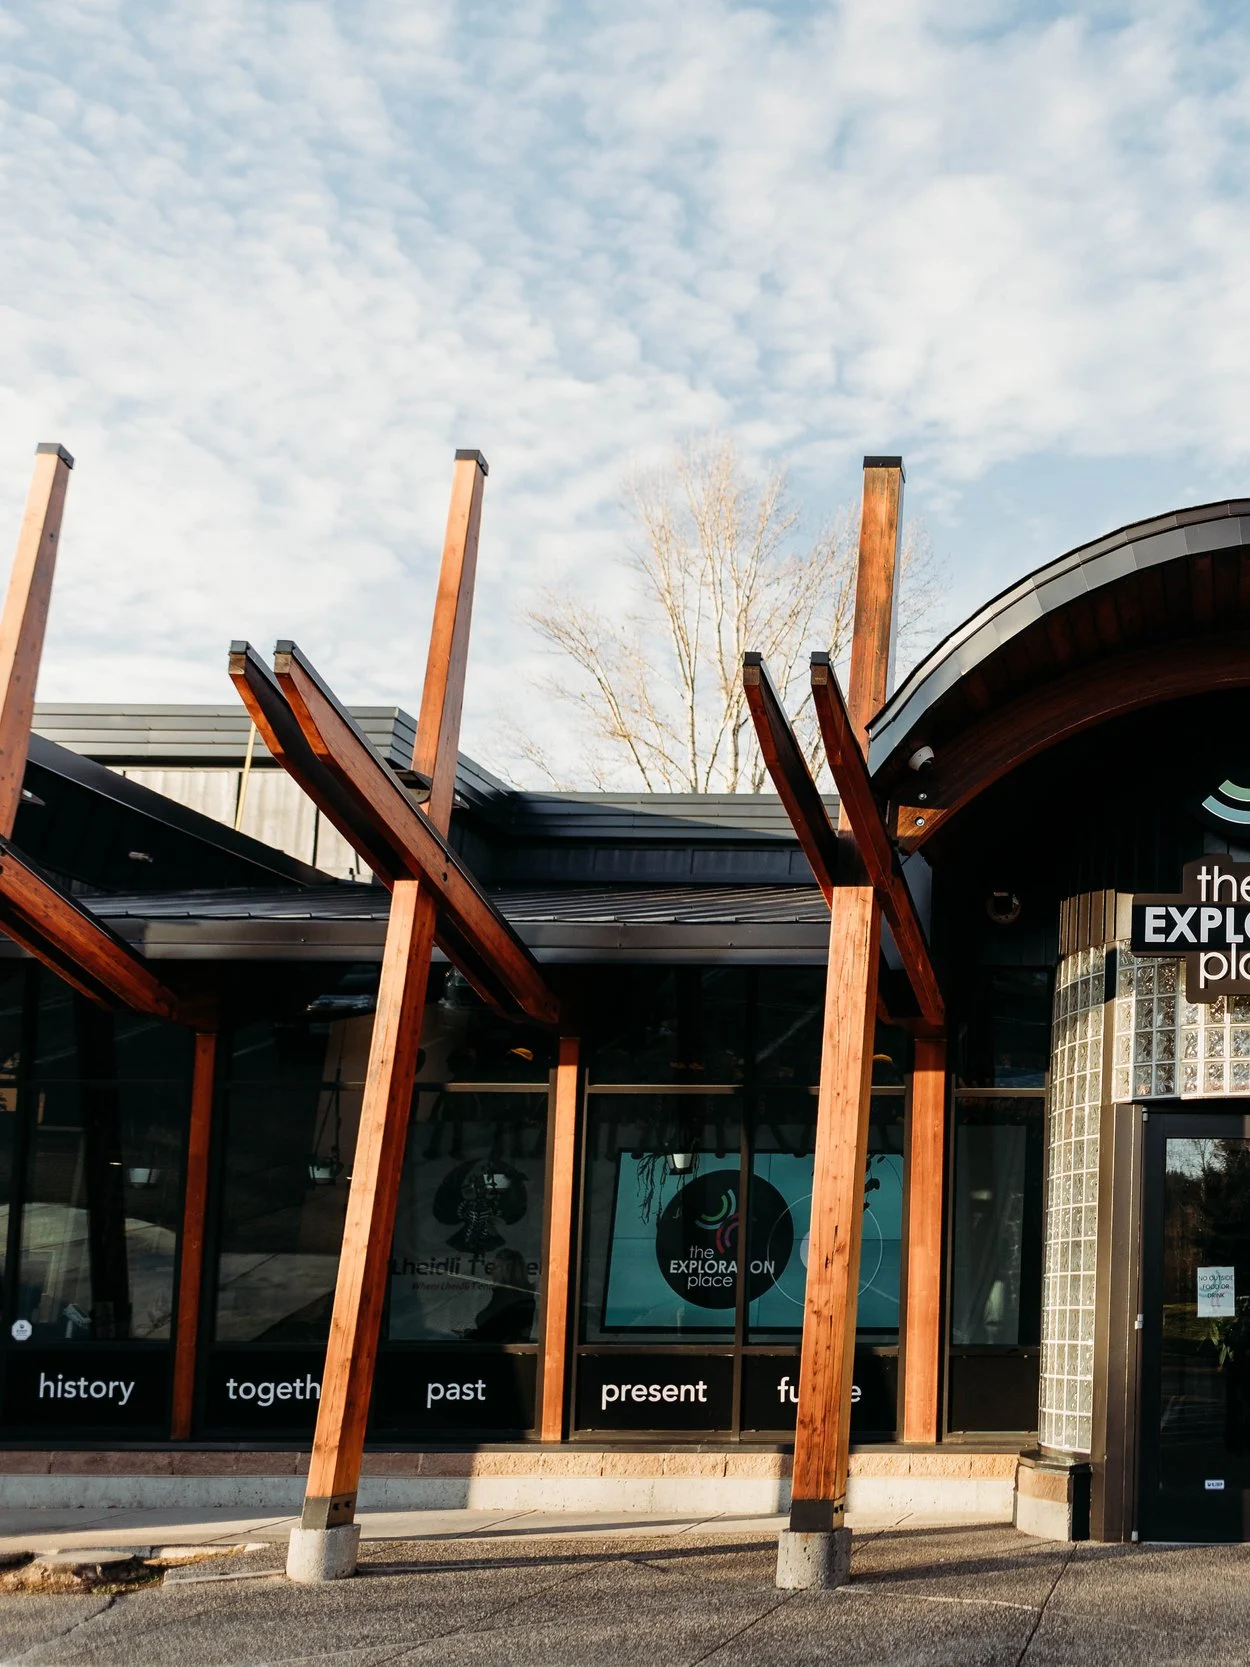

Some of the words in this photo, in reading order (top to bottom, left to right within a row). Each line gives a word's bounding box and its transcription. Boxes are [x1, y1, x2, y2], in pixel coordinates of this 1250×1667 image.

[689, 1245, 715, 1259] the
[391, 1257, 461, 1275] Lheidli
[669, 1260, 775, 1274] EXPLORAON
[687, 1274, 733, 1290] place
[39, 1373, 135, 1406] history
[226, 1374, 321, 1407] togeth
[427, 1380, 486, 1409] past
[602, 1381, 707, 1410] present
[777, 1377, 862, 1403] fue
